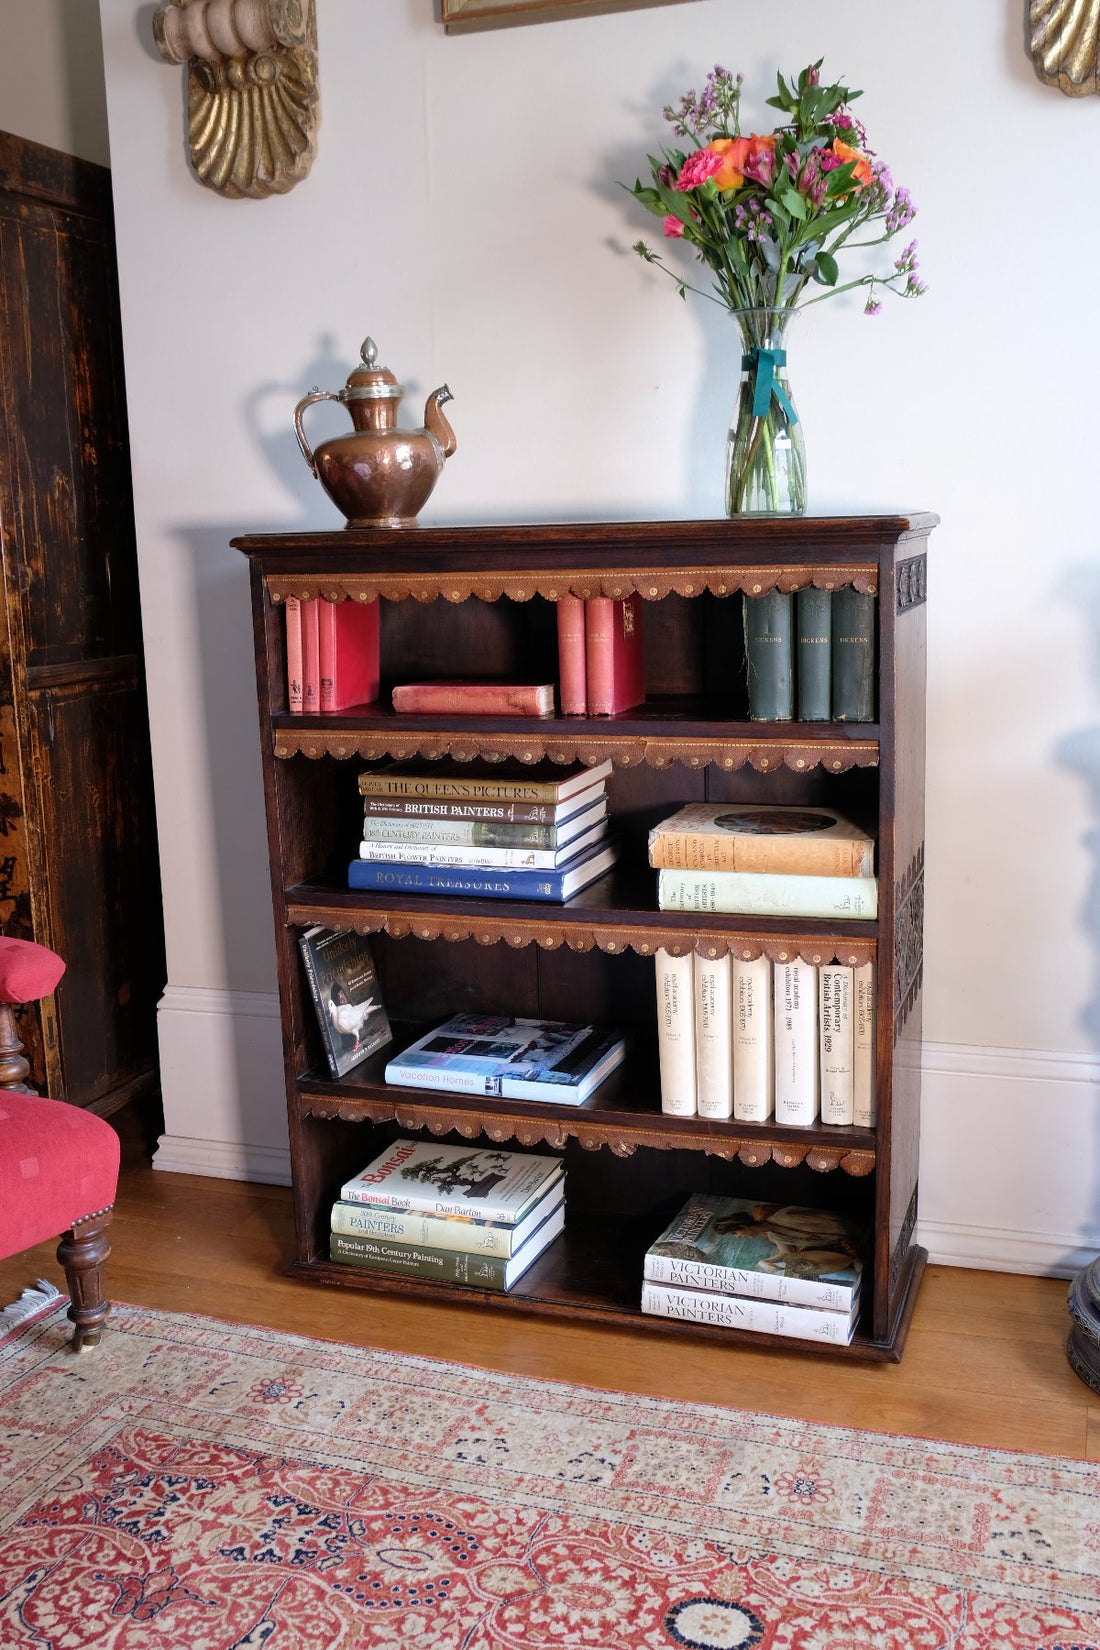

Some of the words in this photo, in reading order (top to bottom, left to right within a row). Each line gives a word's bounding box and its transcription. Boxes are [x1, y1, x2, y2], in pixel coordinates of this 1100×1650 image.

[385, 782, 412, 794] THE
[414, 783, 470, 797] QUEEN'S
[473, 786, 539, 799] PICTURES
[404, 803, 447, 815] BRITISH
[451, 805, 504, 818] PAINTERS
[381, 830, 419, 839] CENTURY
[421, 832, 460, 841] PAINTERS
[376, 872, 423, 886] ROYAL
[427, 875, 510, 892] TREASURES
[823, 973, 832, 1002] British
[832, 973, 842, 1033] Contemporary
[824, 1035, 832, 1053] 1929
[400, 1070, 440, 1083] Vacation
[442, 1076, 474, 1087] Homes
[360, 1146, 416, 1184] Bonsai
[347, 1191, 360, 1201] The
[361, 1192, 390, 1205] Bonsai
[391, 1197, 411, 1208] Book
[435, 1203, 453, 1215] Dan
[454, 1206, 482, 1217] Barton
[350, 1216, 404, 1235] PAINTERS
[338, 1239, 364, 1251] Popular
[365, 1244, 380, 1254] 19th
[381, 1247, 413, 1261] Century
[412, 1252, 444, 1266] Painting
[670, 1260, 749, 1283] VICTORIAN
[670, 1272, 736, 1292] PAINTERS
[666, 1294, 746, 1316] VICTORIAN
[667, 1305, 733, 1325] PAINTERS
